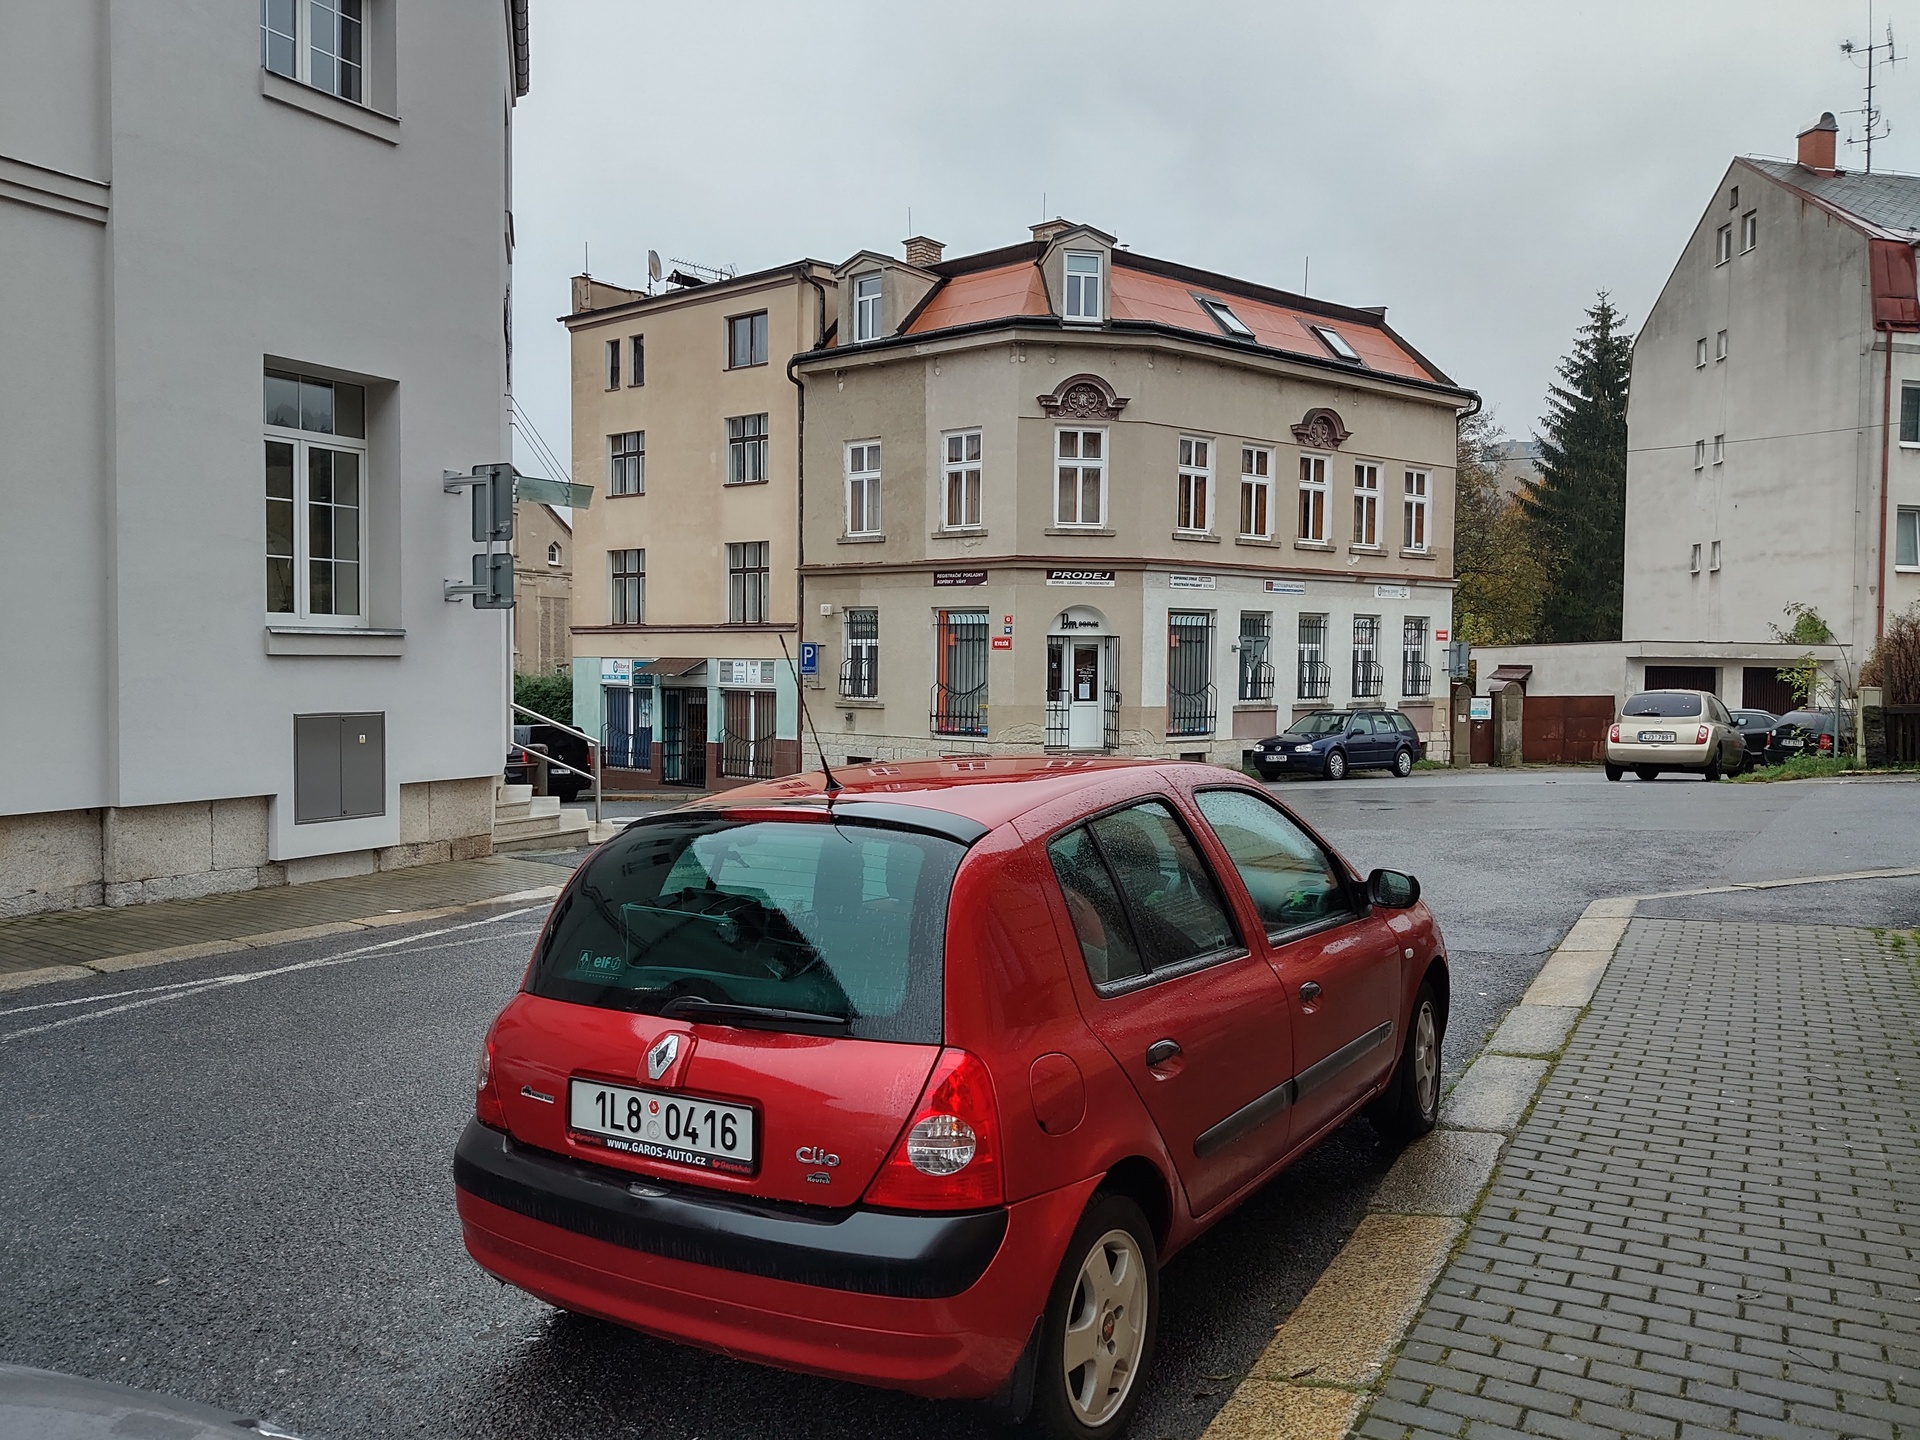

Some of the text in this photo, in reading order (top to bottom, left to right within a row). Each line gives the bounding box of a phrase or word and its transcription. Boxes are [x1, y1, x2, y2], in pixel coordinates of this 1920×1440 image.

[1052, 571, 1111, 580] PRODEJ
[804, 646, 814, 665] P
[593, 956, 611, 969] elf
[595, 1091, 738, 1150] 1L8 0416
[607, 1138, 706, 1166] www.GAROS-AUTO.cz
[795, 1146, 840, 1167] Clio
